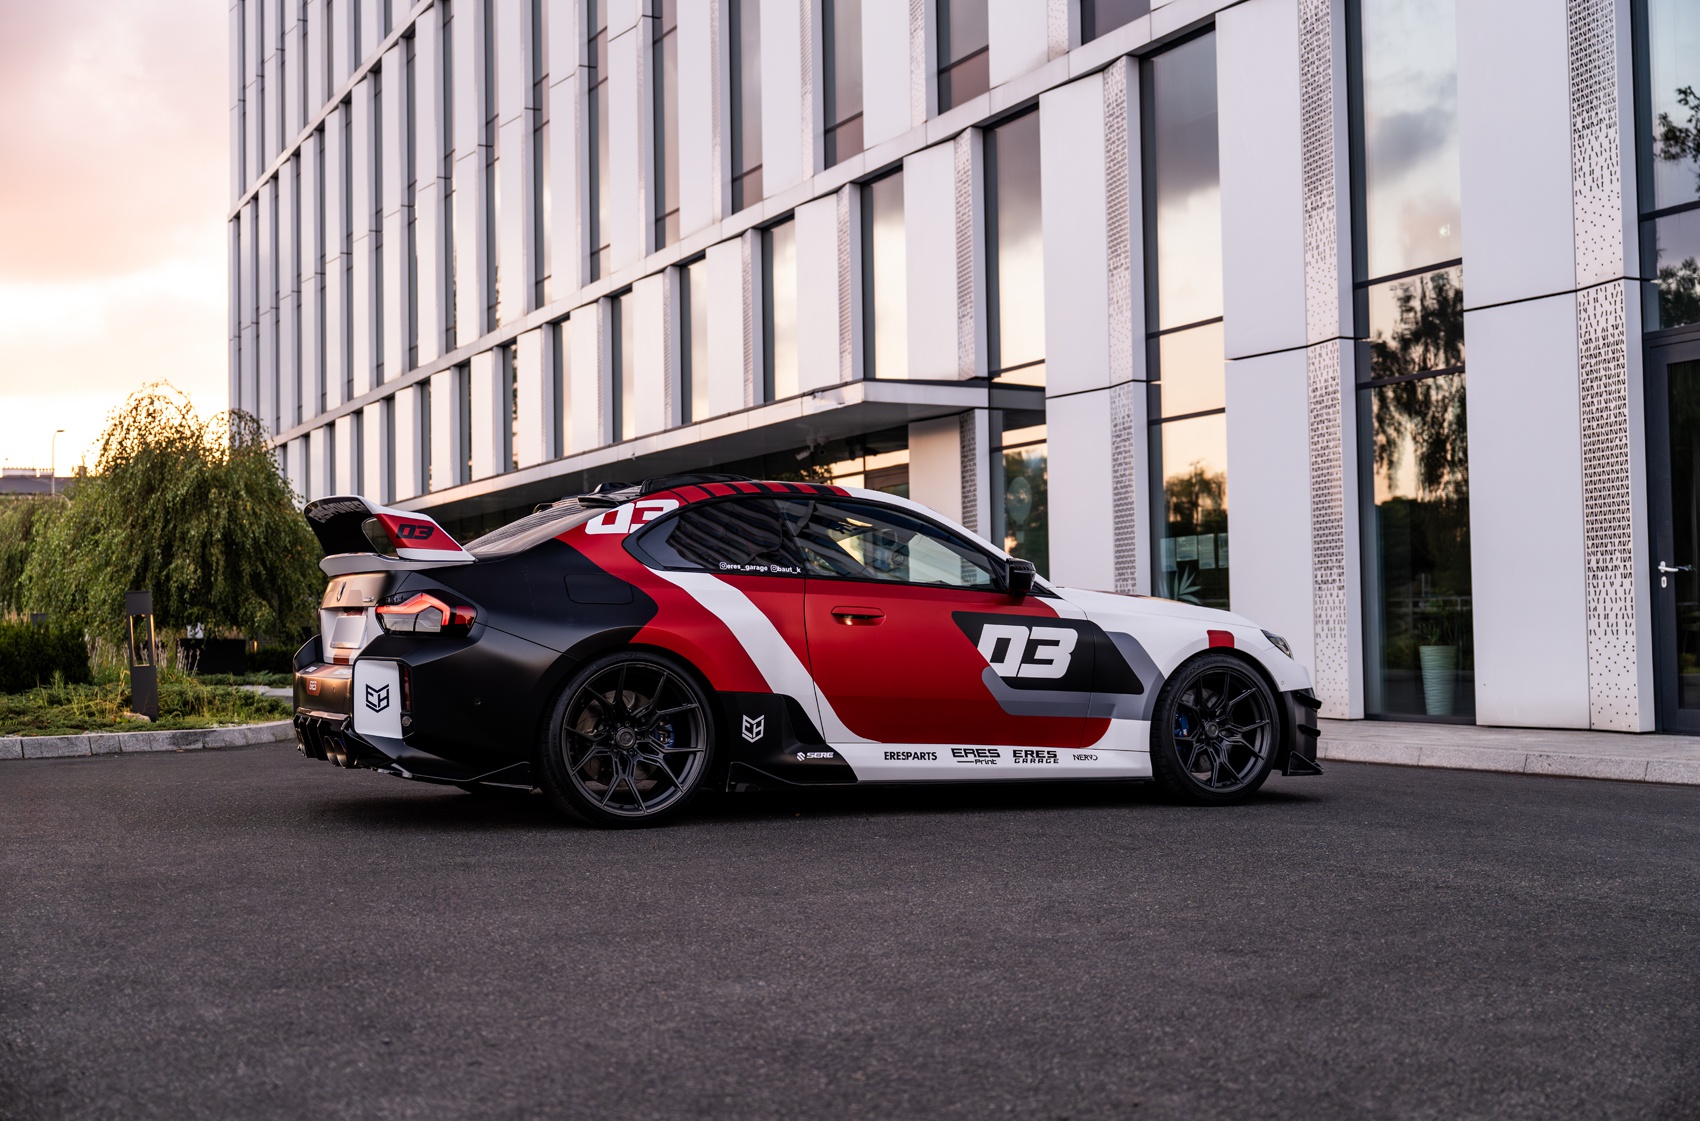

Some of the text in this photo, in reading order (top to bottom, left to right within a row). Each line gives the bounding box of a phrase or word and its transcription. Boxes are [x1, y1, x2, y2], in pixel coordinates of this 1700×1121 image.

[396, 523, 434, 540] 03
[726, 563, 801, 574] eres_garage baut_k
[977, 624, 1078, 678] 03
[884, 751, 937, 760] ERESPARTS
[951, 748, 1001, 758] ERES
[1012, 749, 1057, 758] ERES
